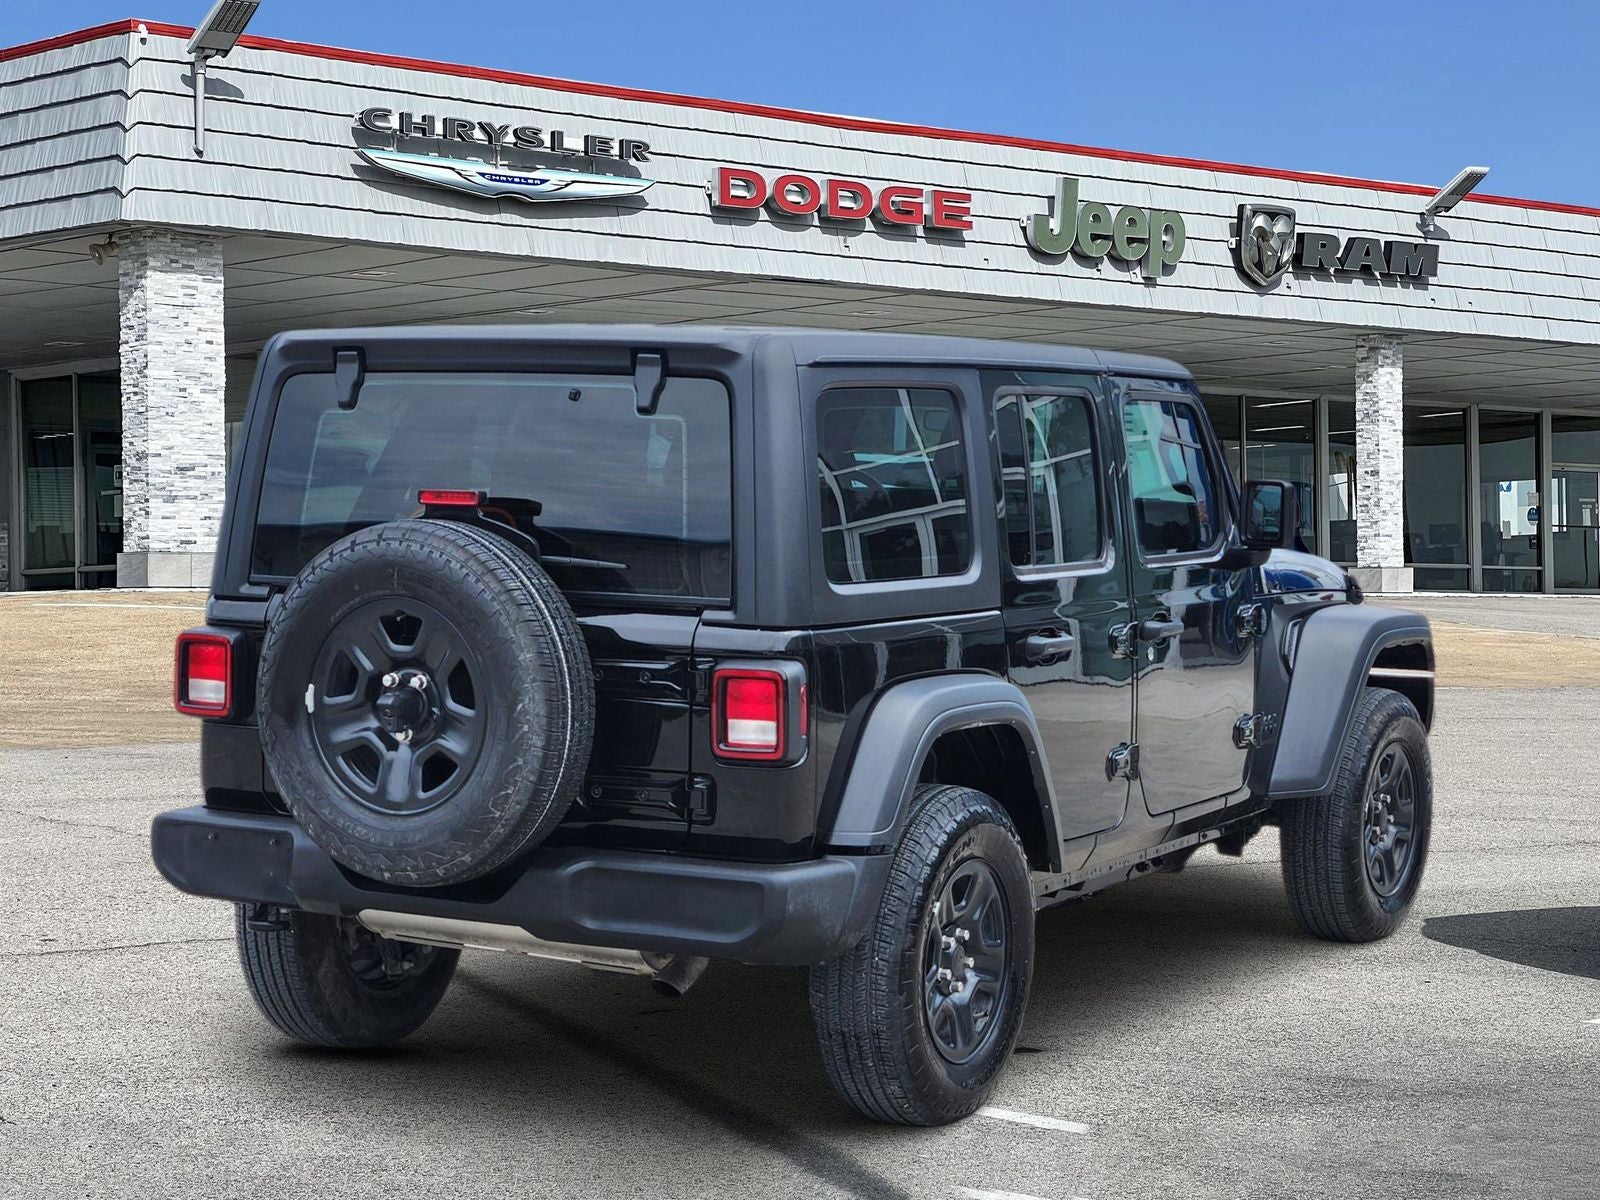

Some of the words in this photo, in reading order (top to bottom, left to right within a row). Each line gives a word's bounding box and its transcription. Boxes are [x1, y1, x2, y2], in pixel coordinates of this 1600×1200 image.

[359, 107, 651, 162] CHRYSLER
[484, 174, 541, 185] CHRYSLER
[712, 167, 973, 230] DODGE
[1027, 177, 1186, 278] Jeep
[1296, 232, 1439, 277] RAM
